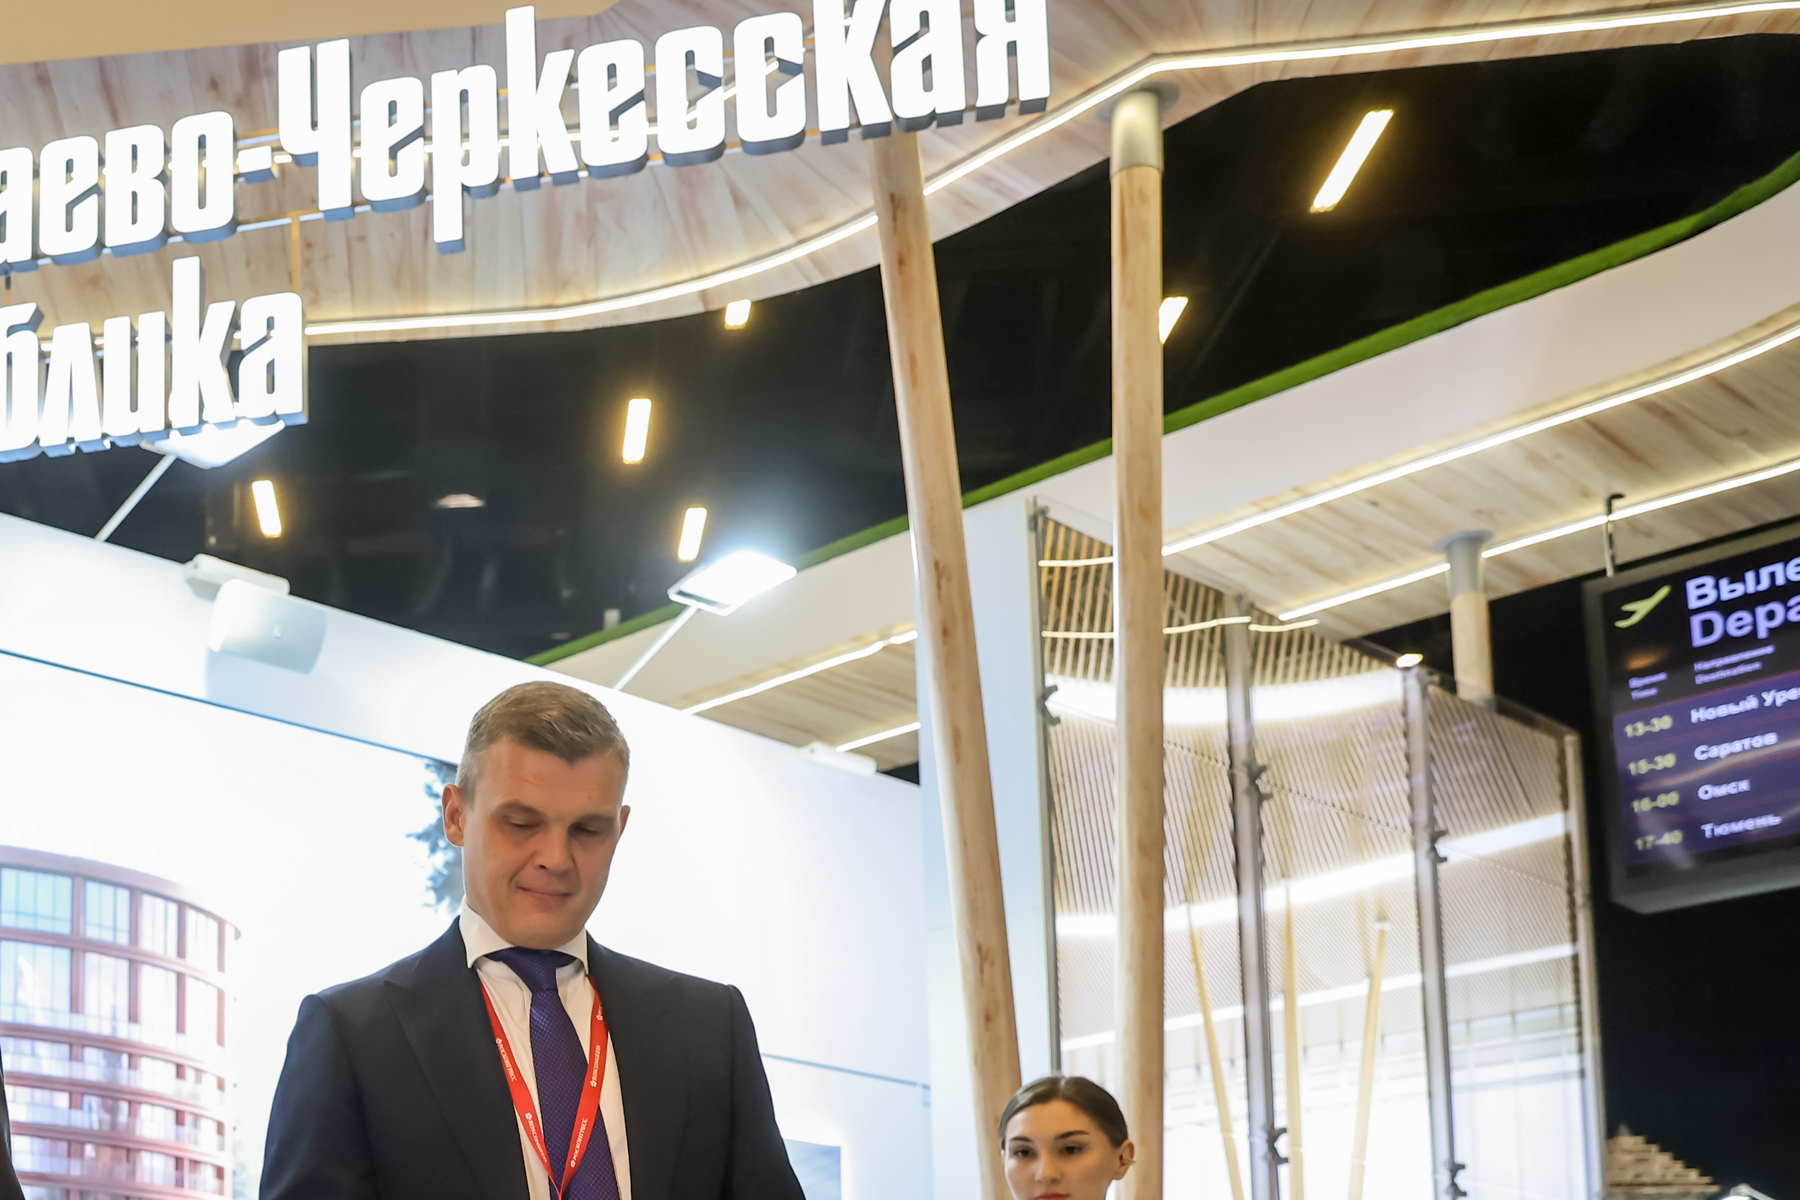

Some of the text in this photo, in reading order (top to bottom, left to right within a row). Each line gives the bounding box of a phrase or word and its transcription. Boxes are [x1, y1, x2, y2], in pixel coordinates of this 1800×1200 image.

[1690, 693, 1760, 724] Новый
[1693, 731, 1779, 761] Саратов
[1697, 778, 1751, 801] Омск
[1700, 813, 1783, 839] Тюмень
